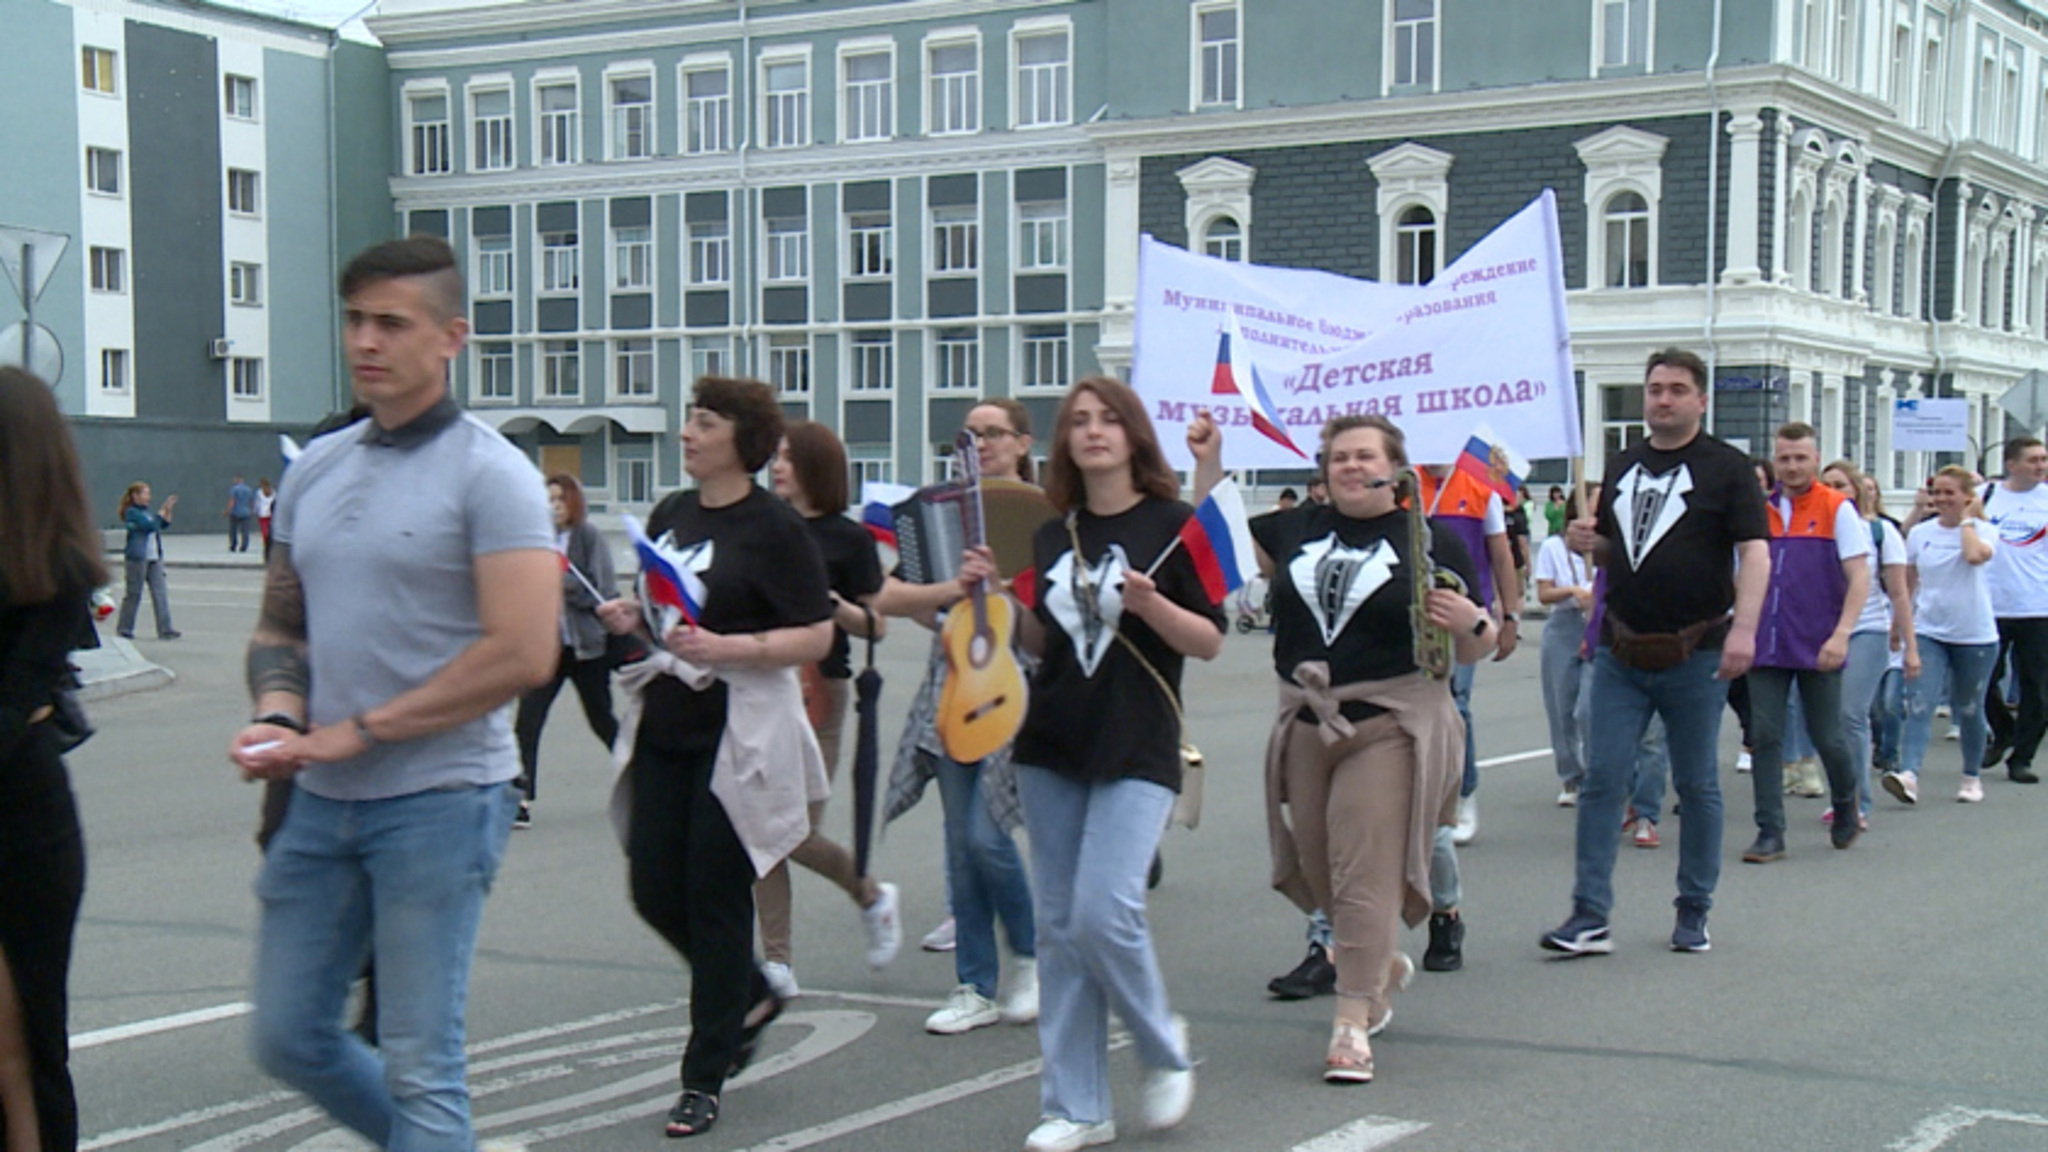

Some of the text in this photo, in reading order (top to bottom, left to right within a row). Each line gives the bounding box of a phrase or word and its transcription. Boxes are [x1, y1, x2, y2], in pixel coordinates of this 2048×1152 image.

[1163, 288, 1314, 331] Муниипальное
[1396, 289, 1498, 325] разования
[1284, 352, 1434, 395] «Детская
[1416, 378, 1547, 414] школа»
